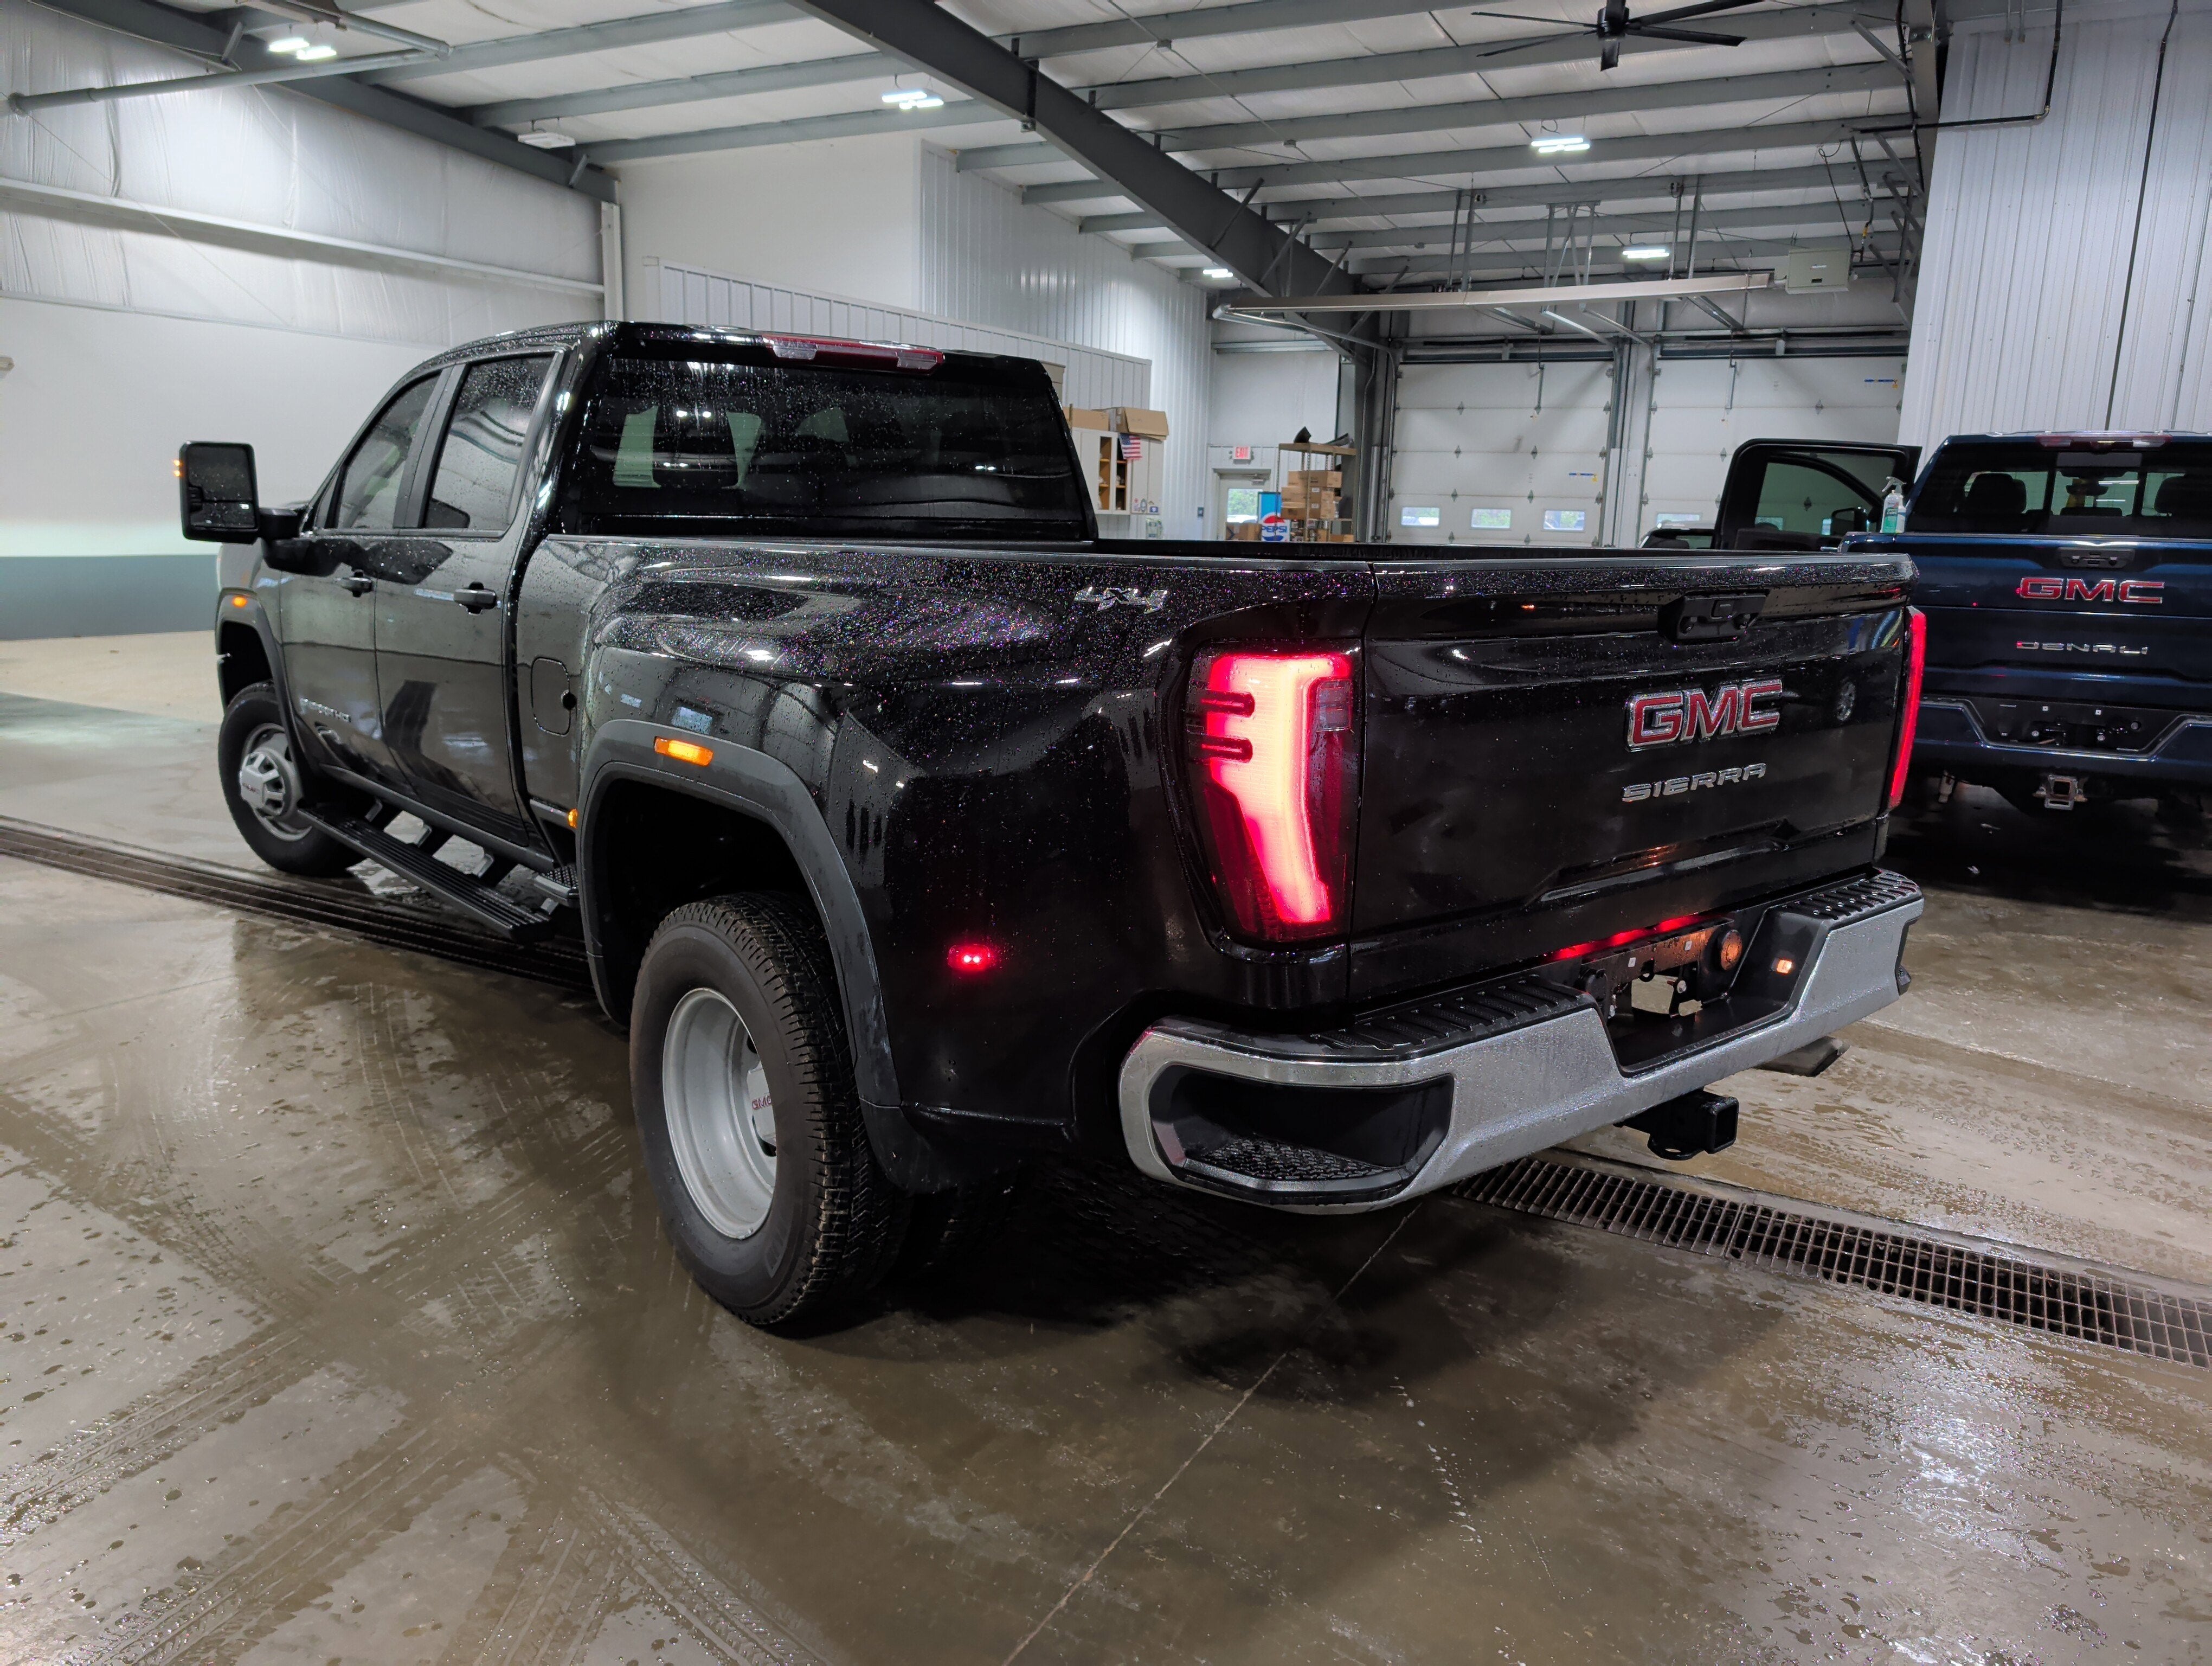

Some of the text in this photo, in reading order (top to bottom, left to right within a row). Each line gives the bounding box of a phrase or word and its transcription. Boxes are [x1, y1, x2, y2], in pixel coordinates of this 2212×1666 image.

[1236, 447, 1249, 458] EXIT
[2020, 577, 2165, 604] GMC
[2016, 641, 2148, 655] DENALI
[1628, 678, 1783, 748] GMC
[1622, 762, 1766, 802] SIERRA
